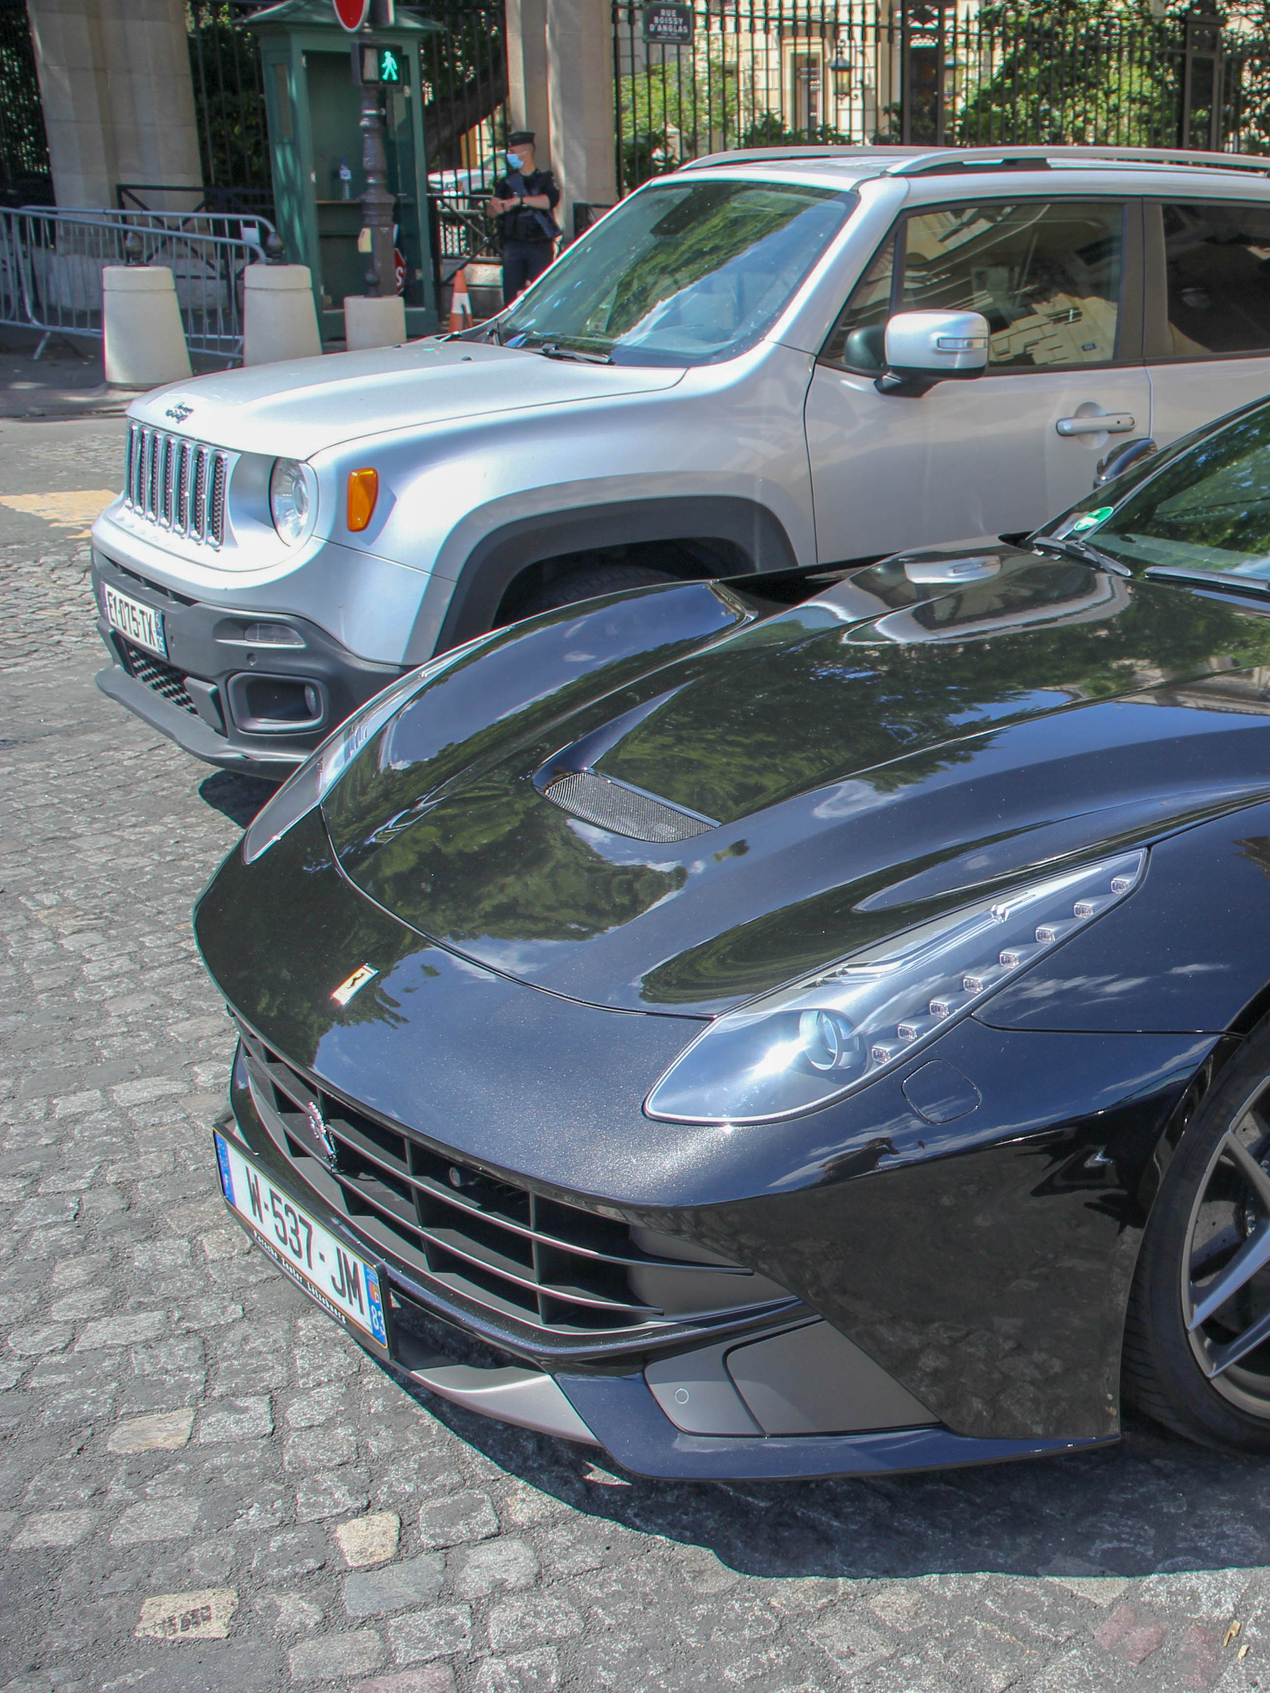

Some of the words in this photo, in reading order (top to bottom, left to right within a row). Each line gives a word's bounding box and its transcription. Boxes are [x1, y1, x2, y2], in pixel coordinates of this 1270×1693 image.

[654, 16, 683, 24] BOISSY
[649, 23, 689, 33] D'ANGLAS
[371, 1305, 386, 1335] 83
